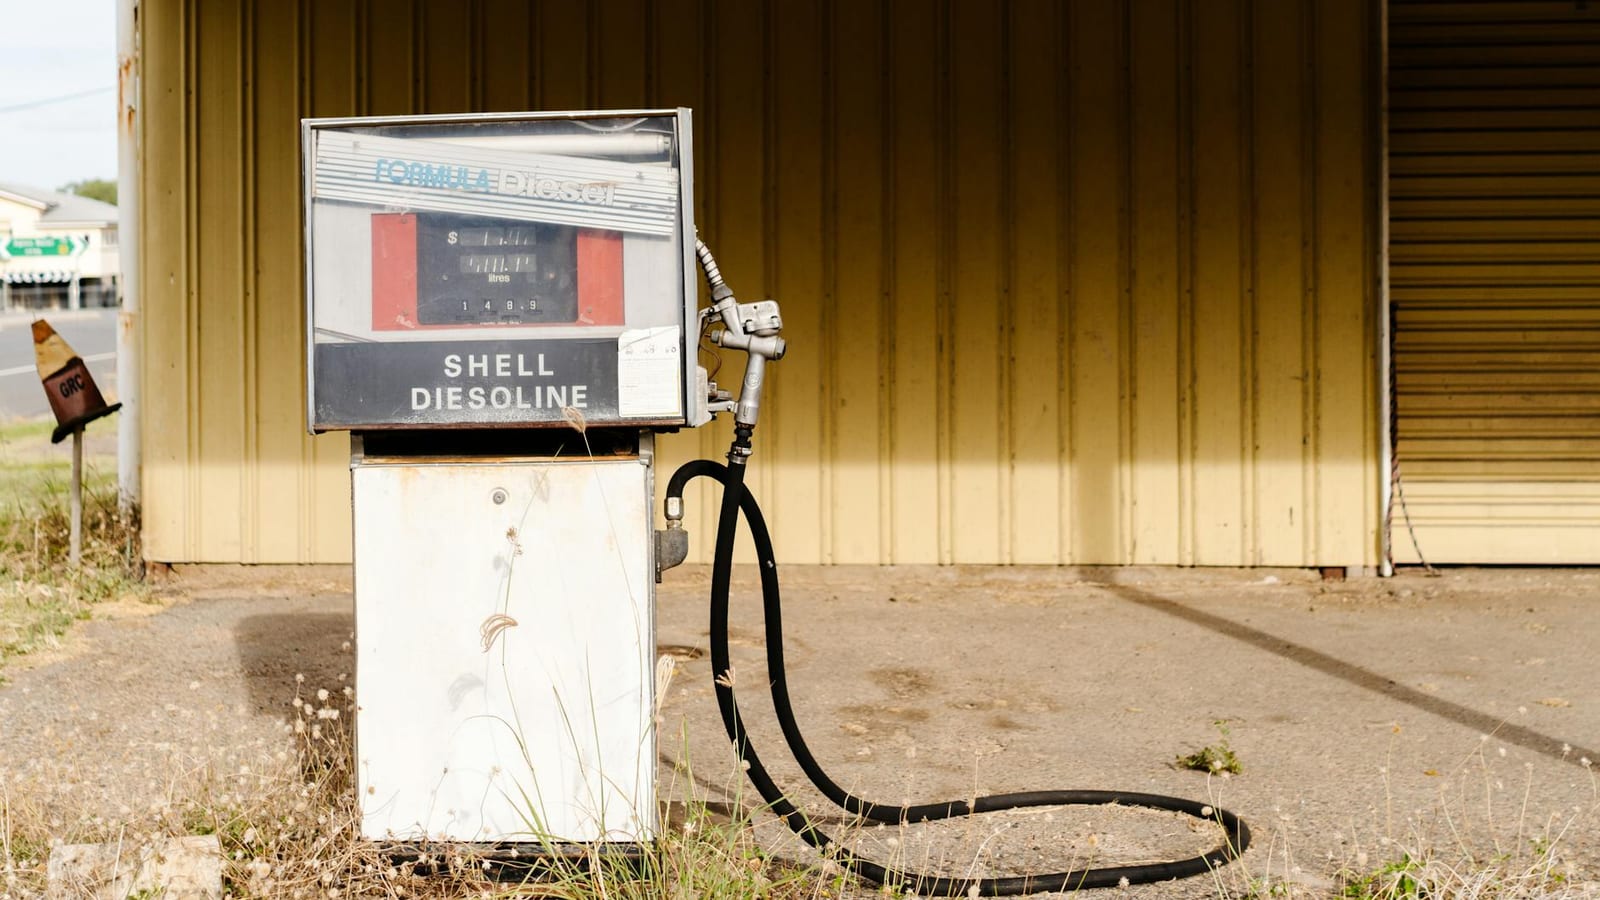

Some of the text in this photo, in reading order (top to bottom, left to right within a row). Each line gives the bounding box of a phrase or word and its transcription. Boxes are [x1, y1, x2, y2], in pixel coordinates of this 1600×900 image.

[375, 158, 616, 206] FORMULA Diesel
[447, 231, 458, 245] $
[488, 273, 511, 283] litres
[444, 353, 554, 378] SHELL
[59, 373, 85, 399] GRC
[411, 385, 588, 410] DIESOLINE
